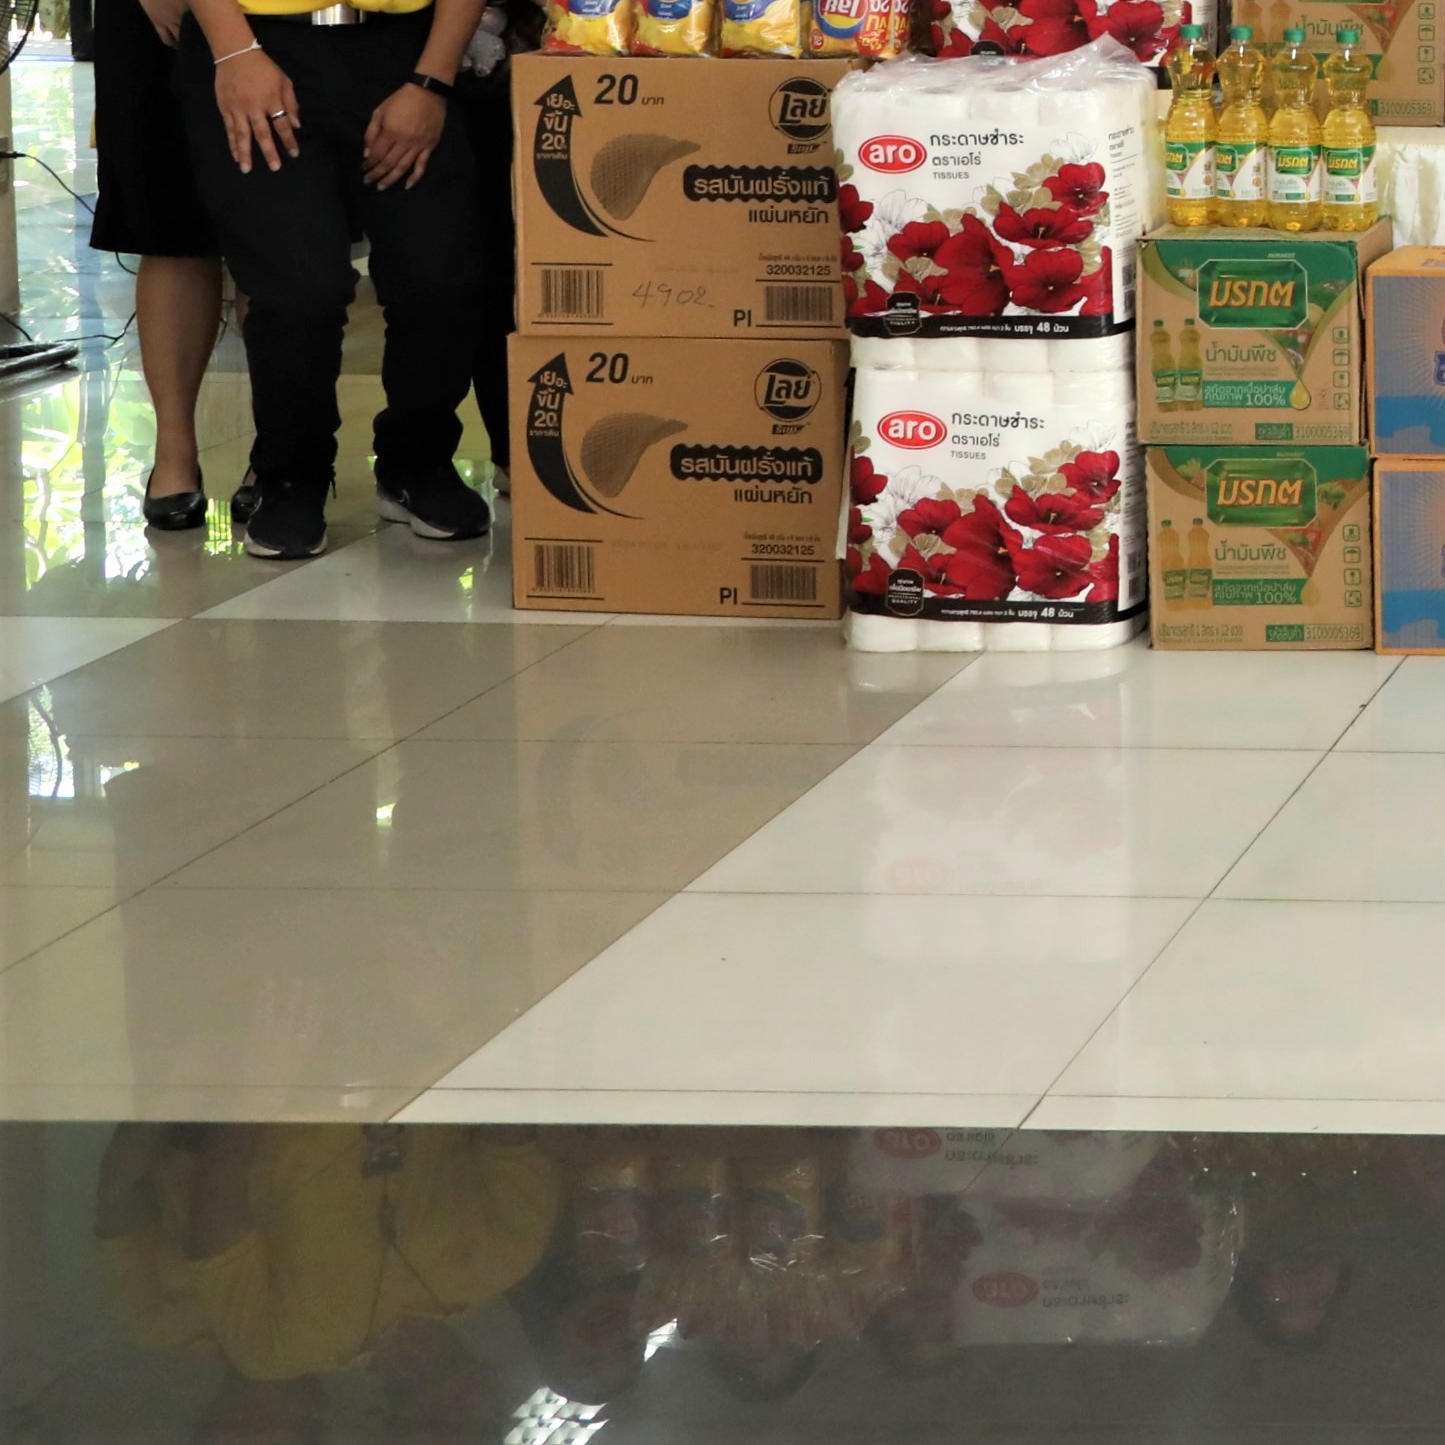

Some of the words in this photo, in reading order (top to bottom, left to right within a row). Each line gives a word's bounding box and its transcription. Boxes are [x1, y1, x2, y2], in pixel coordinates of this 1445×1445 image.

[593, 73, 639, 106] 20
[780, 89, 829, 125] เลย์
[930, 128, 1025, 147] กระดาษชำระ
[868, 141, 917, 165] aro
[932, 151, 982, 167] ตราเอโร่
[1278, 155, 1309, 168] มรกต
[1328, 156, 1358, 169] มรกต
[693, 170, 829, 197] รสมันฝรั่งแท้
[932, 171, 970, 180] TISSUES
[748, 204, 829, 225] แผ่นหยัก
[765, 264, 832, 277] 320032125
[1209, 278, 1295, 308] มรกต
[733, 309, 753, 328] PI
[1036, 321, 1051, 333] 48
[1205, 340, 1277, 363] น้ำมันพืช
[585, 352, 630, 385] 20
[766, 372, 815, 406] เลย์
[1246, 393, 1286, 406] 100%
[887, 418, 937, 441] aro
[951, 411, 1045, 430] กระดาษชำระ
[951, 433, 1000, 448] ตราเอโร่
[680, 450, 813, 478] รสมันฝรั่งแท้
[950, 450, 987, 460] TISSUES
[734, 485, 813, 505] แผ่นหยัก
[1216, 477, 1303, 506] มรกต
[751, 543, 815, 556] 320032125
[1214, 541, 1287, 562] น้ำมันพืช
[719, 588, 738, 605] PI
[1255, 591, 1297, 604] 100%
[1040, 607, 1055, 618] 48
